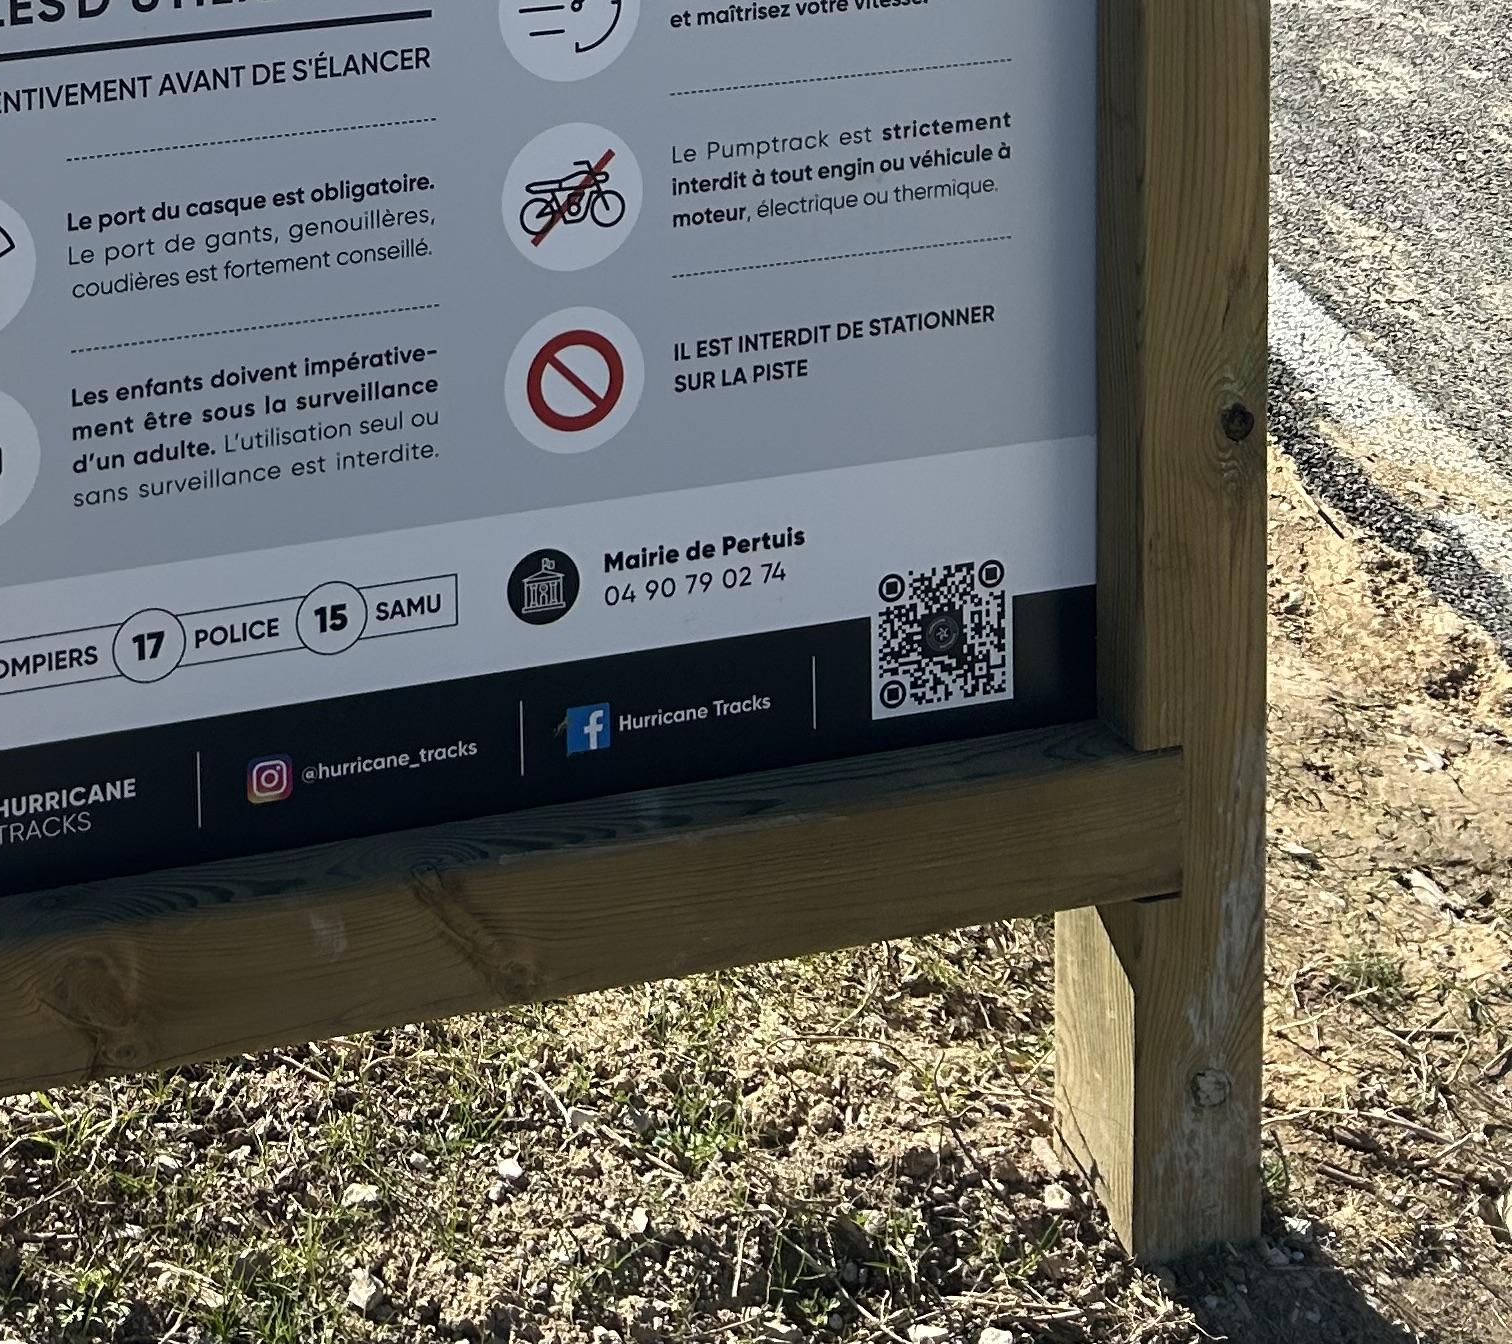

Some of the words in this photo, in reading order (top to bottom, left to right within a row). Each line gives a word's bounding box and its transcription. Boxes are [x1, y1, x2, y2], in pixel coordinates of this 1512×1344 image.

[670, 10, 691, 28] et
[697, 2, 790, 26] maîtrisez
[158, 65, 246, 96] AVANT
[252, 61, 286, 86] DE
[292, 47, 430, 81] S'ÉLANCER
[672, 146, 696, 164] Le
[708, 130, 829, 160] Pumptrack
[839, 127, 872, 145] est
[882, 112, 1011, 141] strictement
[672, 171, 747, 196] interdit
[752, 169, 765, 187] à
[770, 165, 813, 184] tout
[818, 157, 874, 181] engin
[880, 157, 904, 173] ou
[909, 144, 993, 169] véhicule
[998, 142, 1010, 159] à
[68, 213, 92, 232] Le
[98, 206, 146, 233] port
[152, 202, 180, 221] du
[186, 195, 266, 217] casque
[272, 187, 305, 207] est
[311, 173, 434, 203] obligatoire.
[673, 207, 751, 228] moteur,
[757, 194, 858, 218] électrique
[863, 191, 888, 206] ou
[893, 179, 998, 202] thermique.
[69, 246, 95, 265] Le
[105, 239, 155, 266] port
[165, 234, 195, 253] de
[205, 226, 278, 253] gants,
[289, 209, 435, 243] genouillères,
[72, 272, 180, 298] coudières
[186, 265, 218, 284] est
[224, 251, 330, 279] fortement
[337, 238, 432, 265] conseillé.
[674, 343, 691, 361] IL
[697, 337, 733, 358] EST
[739, 324, 831, 353] INTERDIT
[837, 321, 863, 341] DE
[869, 305, 995, 336] STATIONNER
[72, 388, 108, 407] Les
[116, 375, 203, 401] enfants
[211, 362, 297, 388] doivent
[305, 346, 437, 378] impérative-
[675, 371, 715, 393] SUR
[722, 367, 747, 387] LA
[753, 359, 808, 383] PISTE
[72, 416, 134, 441] ment
[144, 412, 192, 430] être
[202, 403, 255, 423] sous
[265, 395, 286, 414] la
[296, 379, 438, 410] surveillance
[73, 453, 125, 473] d'un
[133, 440, 215, 465] adulte.
[225, 422, 351, 453] L'utilisation
[360, 411, 403, 434] seul
[411, 411, 438, 427] ou
[73, 486, 128, 507] sans
[139, 465, 281, 498] surveillance
[291, 456, 326, 476] est
[337, 443, 439, 470] interdite.
[604, 545, 679, 573] Mairie
[686, 540, 715, 561] de
[722, 526, 805, 556] Pertuis
[605, 583, 636, 606] 04
[645, 577, 676, 600] 90
[685, 572, 712, 594] 79
[722, 566, 752, 589] 02
[761, 561, 786, 584] 74
[132, 631, 165, 661] 17
[195, 618, 279, 649] POLICE
[314, 603, 348, 633] 15
[376, 594, 441, 621] SAMU
[619, 707, 708, 731] Hurricane
[713, 695, 771, 716] Tracks
[301, 741, 478, 783] @hurricane_tracks
